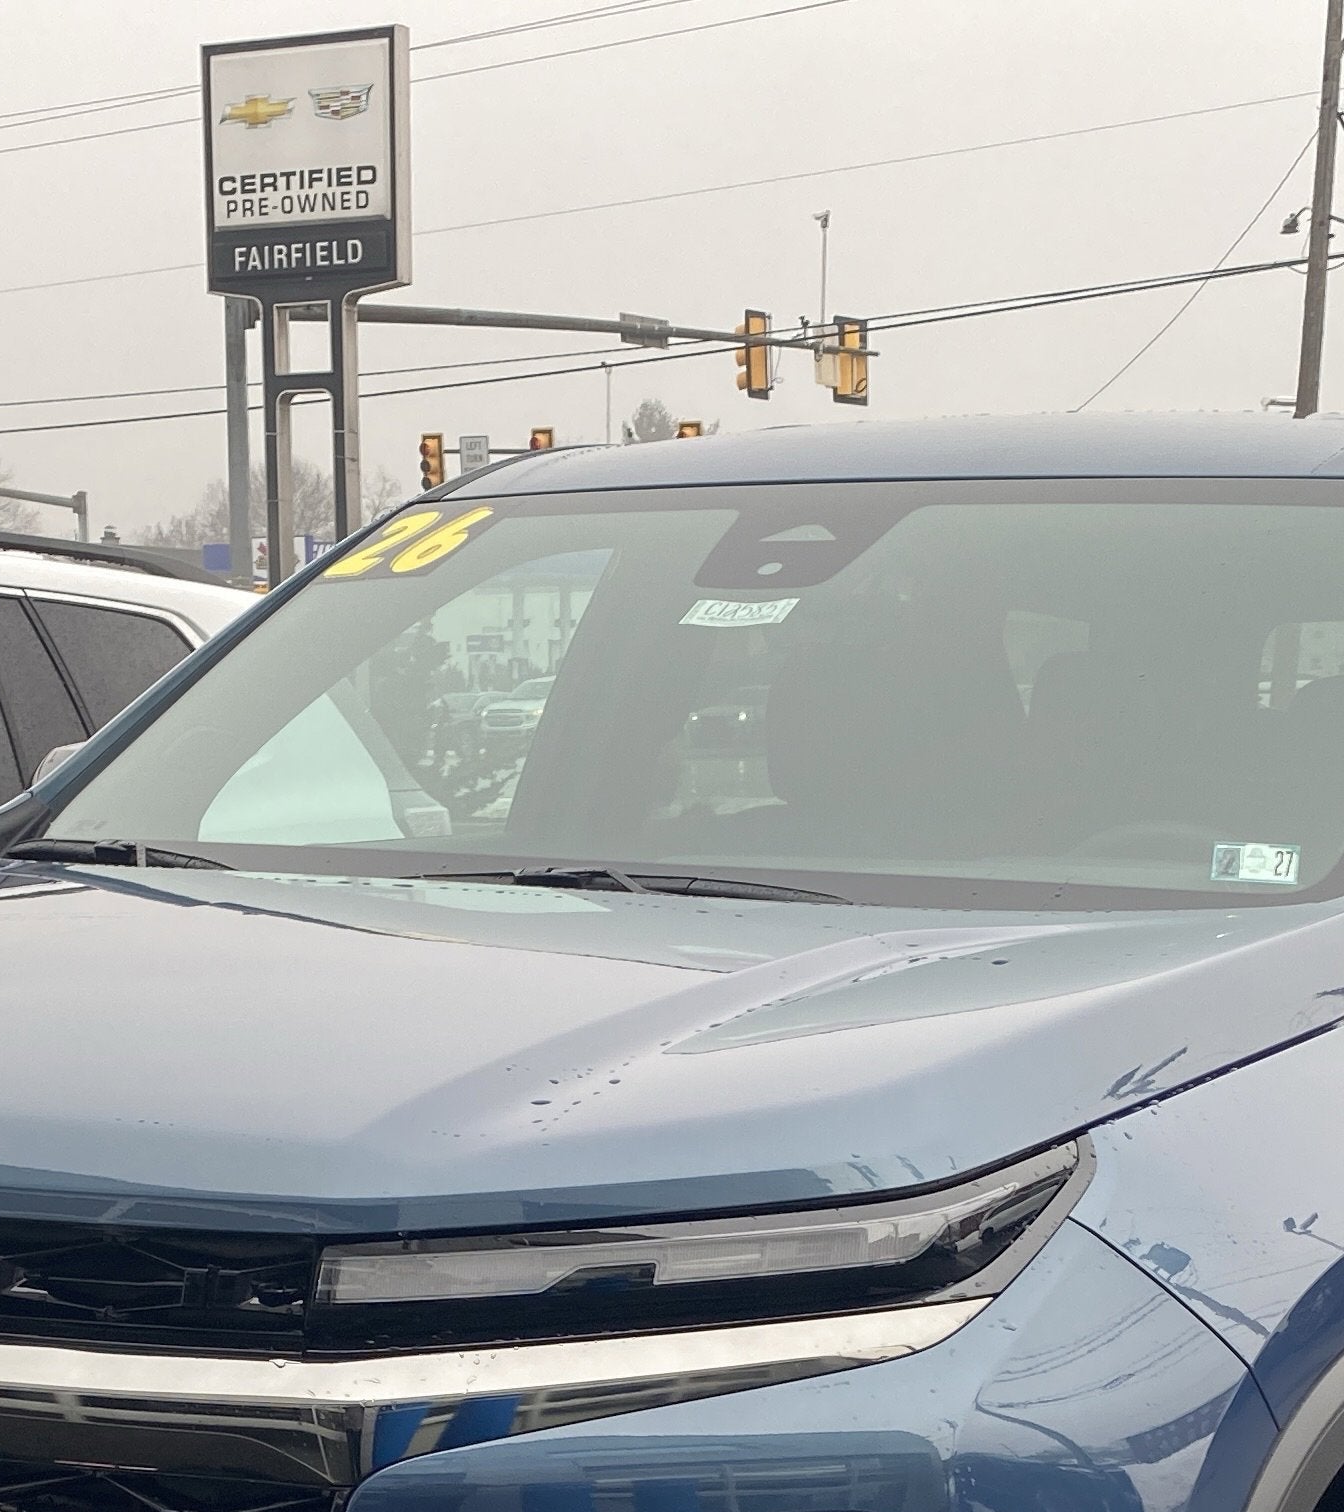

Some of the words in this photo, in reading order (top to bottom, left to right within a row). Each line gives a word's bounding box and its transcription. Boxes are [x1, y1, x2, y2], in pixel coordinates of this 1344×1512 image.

[218, 165, 377, 196] CERTIFIED
[226, 190, 370, 219] PRE-OWNED
[233, 239, 364, 272] FAIRFIELD
[324, 506, 494, 578] 26
[1274, 850, 1294, 878] 27
